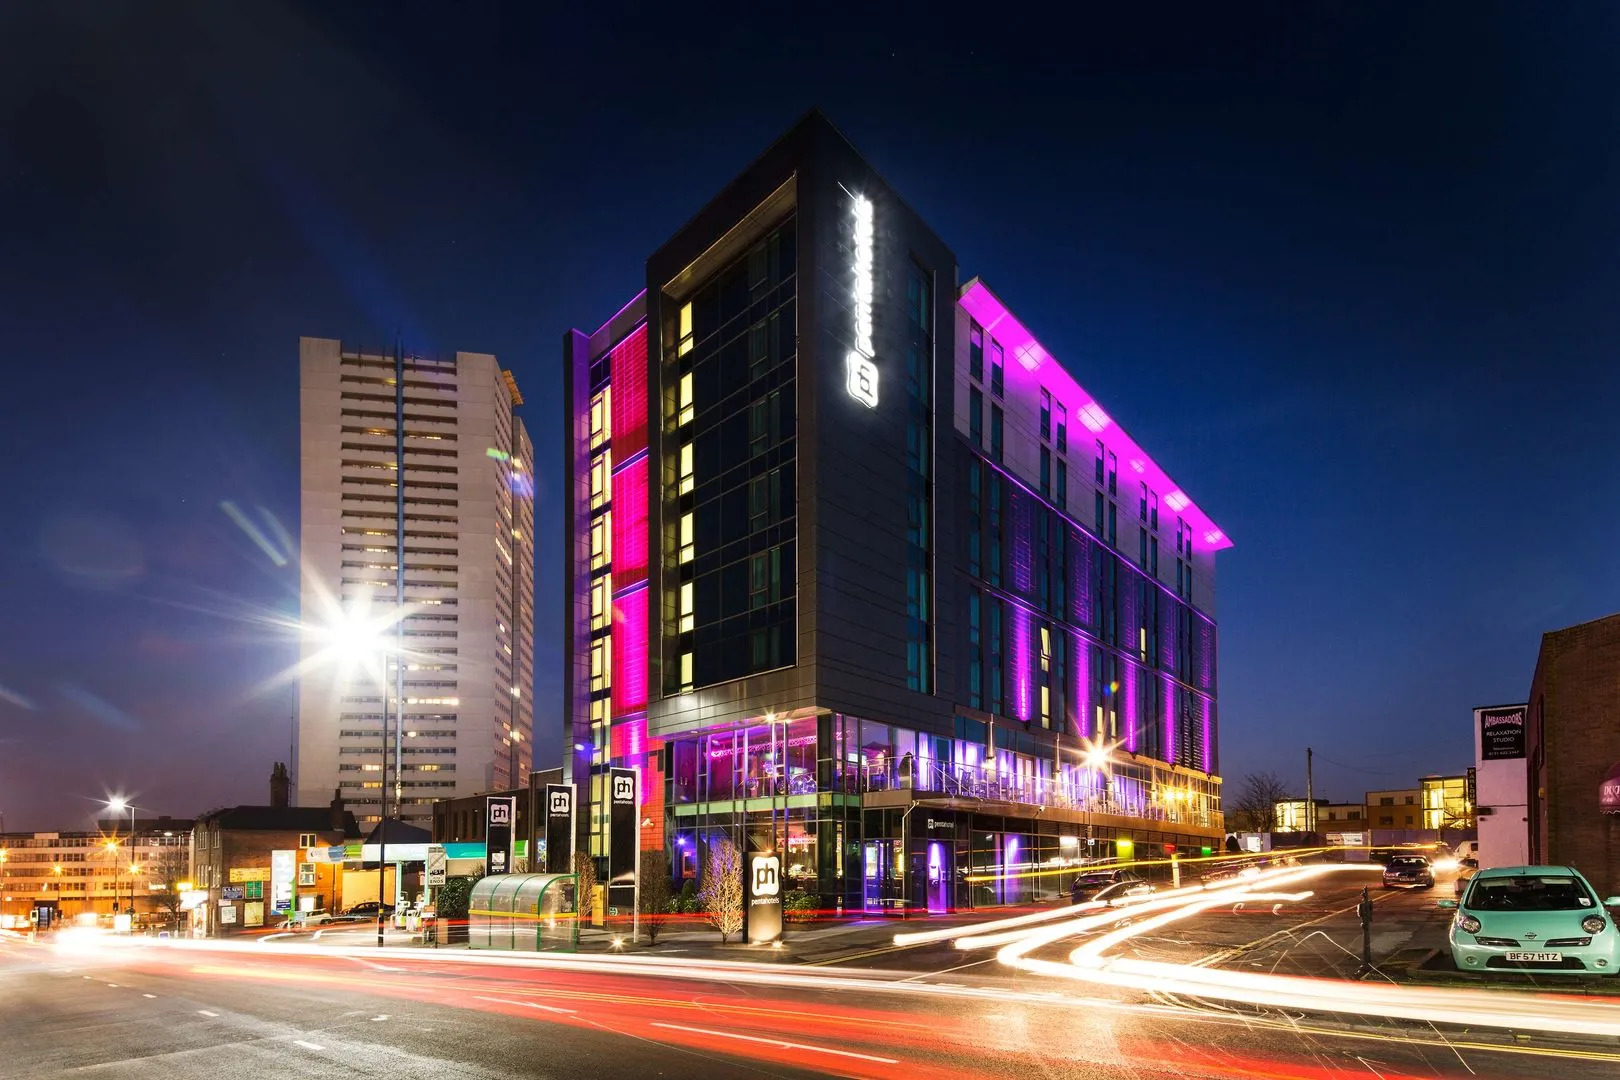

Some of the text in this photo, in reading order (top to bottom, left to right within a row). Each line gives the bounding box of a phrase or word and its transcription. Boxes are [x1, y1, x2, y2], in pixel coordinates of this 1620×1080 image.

[1485, 711, 1522, 728] AMBASSADORS
[617, 780, 631, 796] ph
[553, 794, 567, 809] ph
[493, 807, 506, 820] ph
[756, 862, 775, 890] ph
[751, 897, 780, 906] pentahotels
[1537, 953, 1558, 961] HTZ
